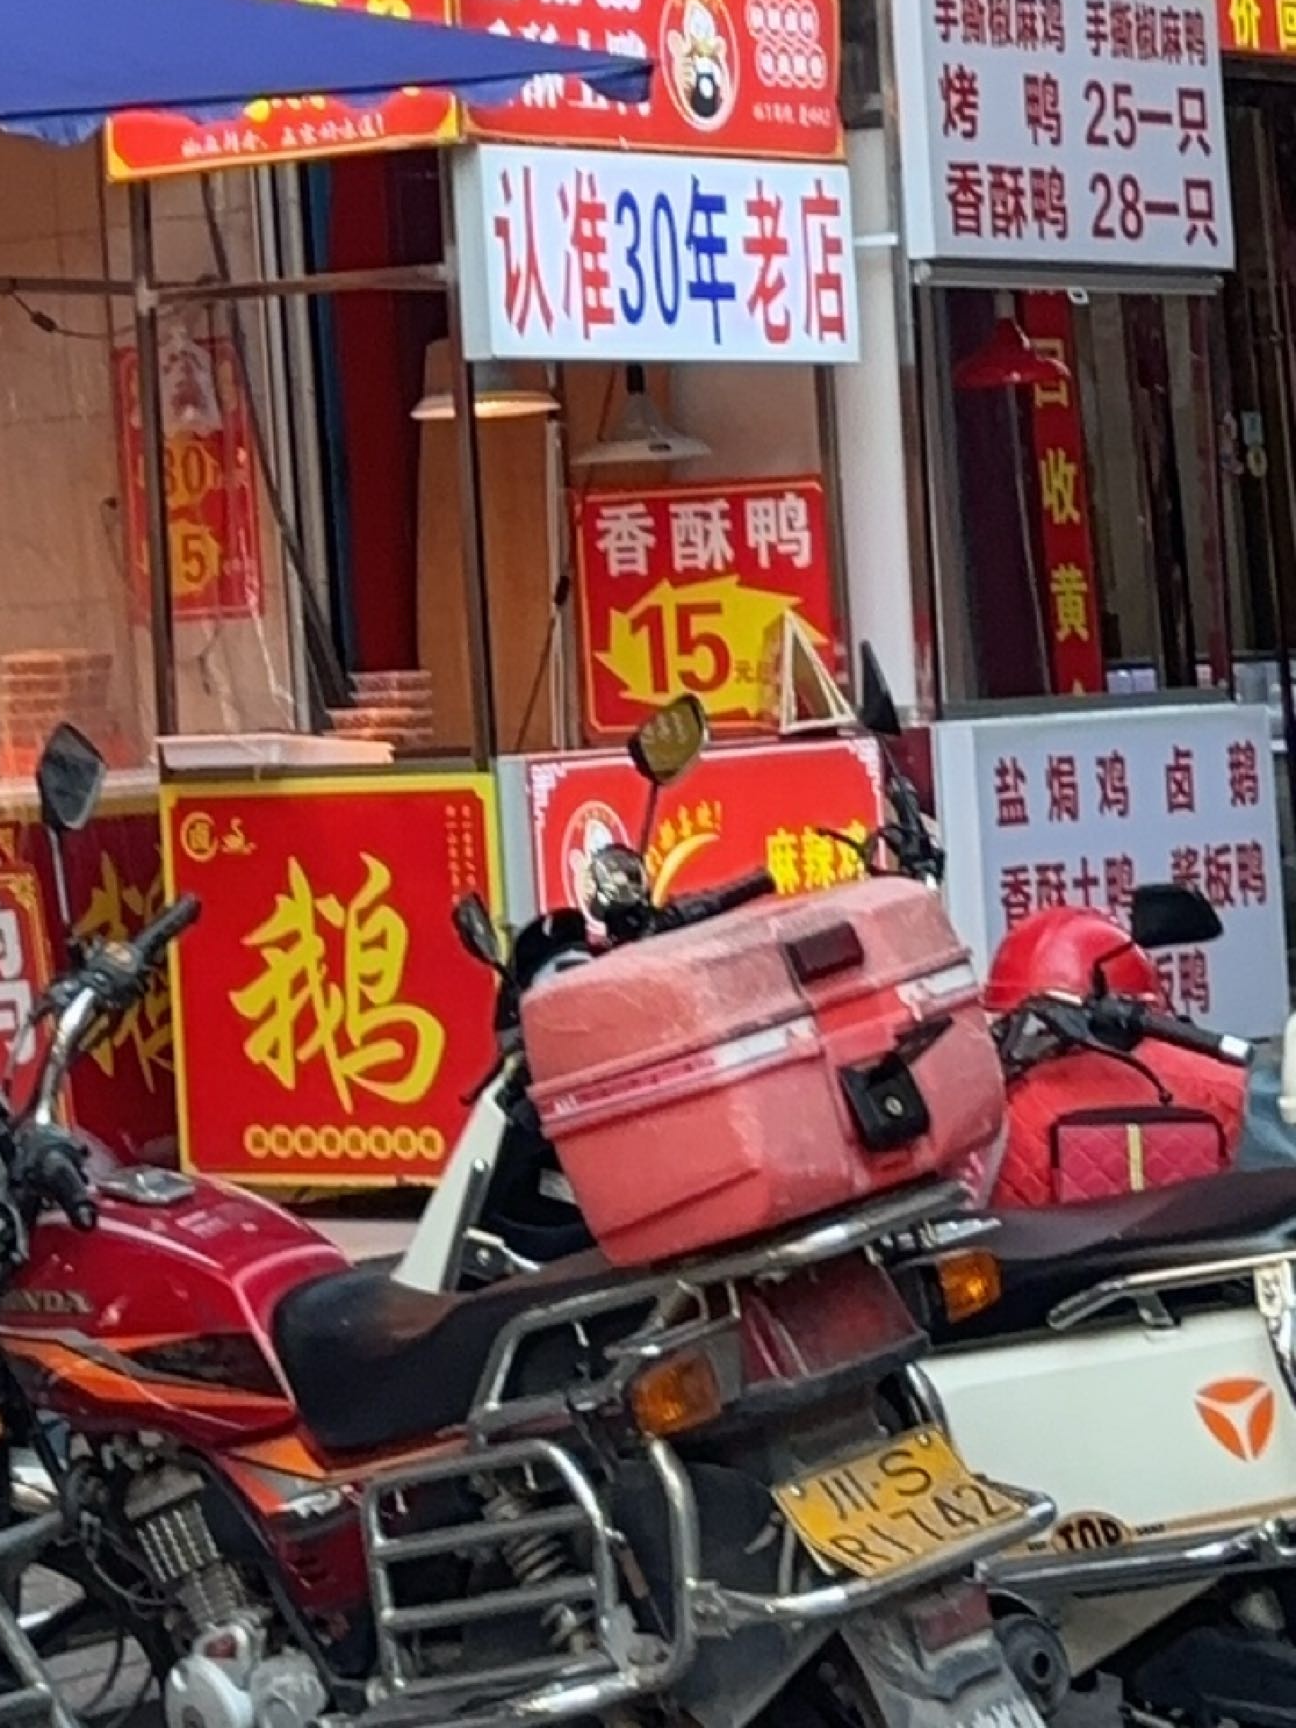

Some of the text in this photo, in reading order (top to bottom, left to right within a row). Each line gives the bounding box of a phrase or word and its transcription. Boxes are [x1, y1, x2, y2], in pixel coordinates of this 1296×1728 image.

[1085, 0, 1207, 66] 手撕椒麻鸭
[945, 161, 1068, 241] 香酥鸭
[494, 165, 847, 346] 认准30年老店
[596, 491, 812, 577] 香酥鸭
[993, 748, 1130, 828] 盐焗鸡
[229, 850, 446, 1115] 鹅
